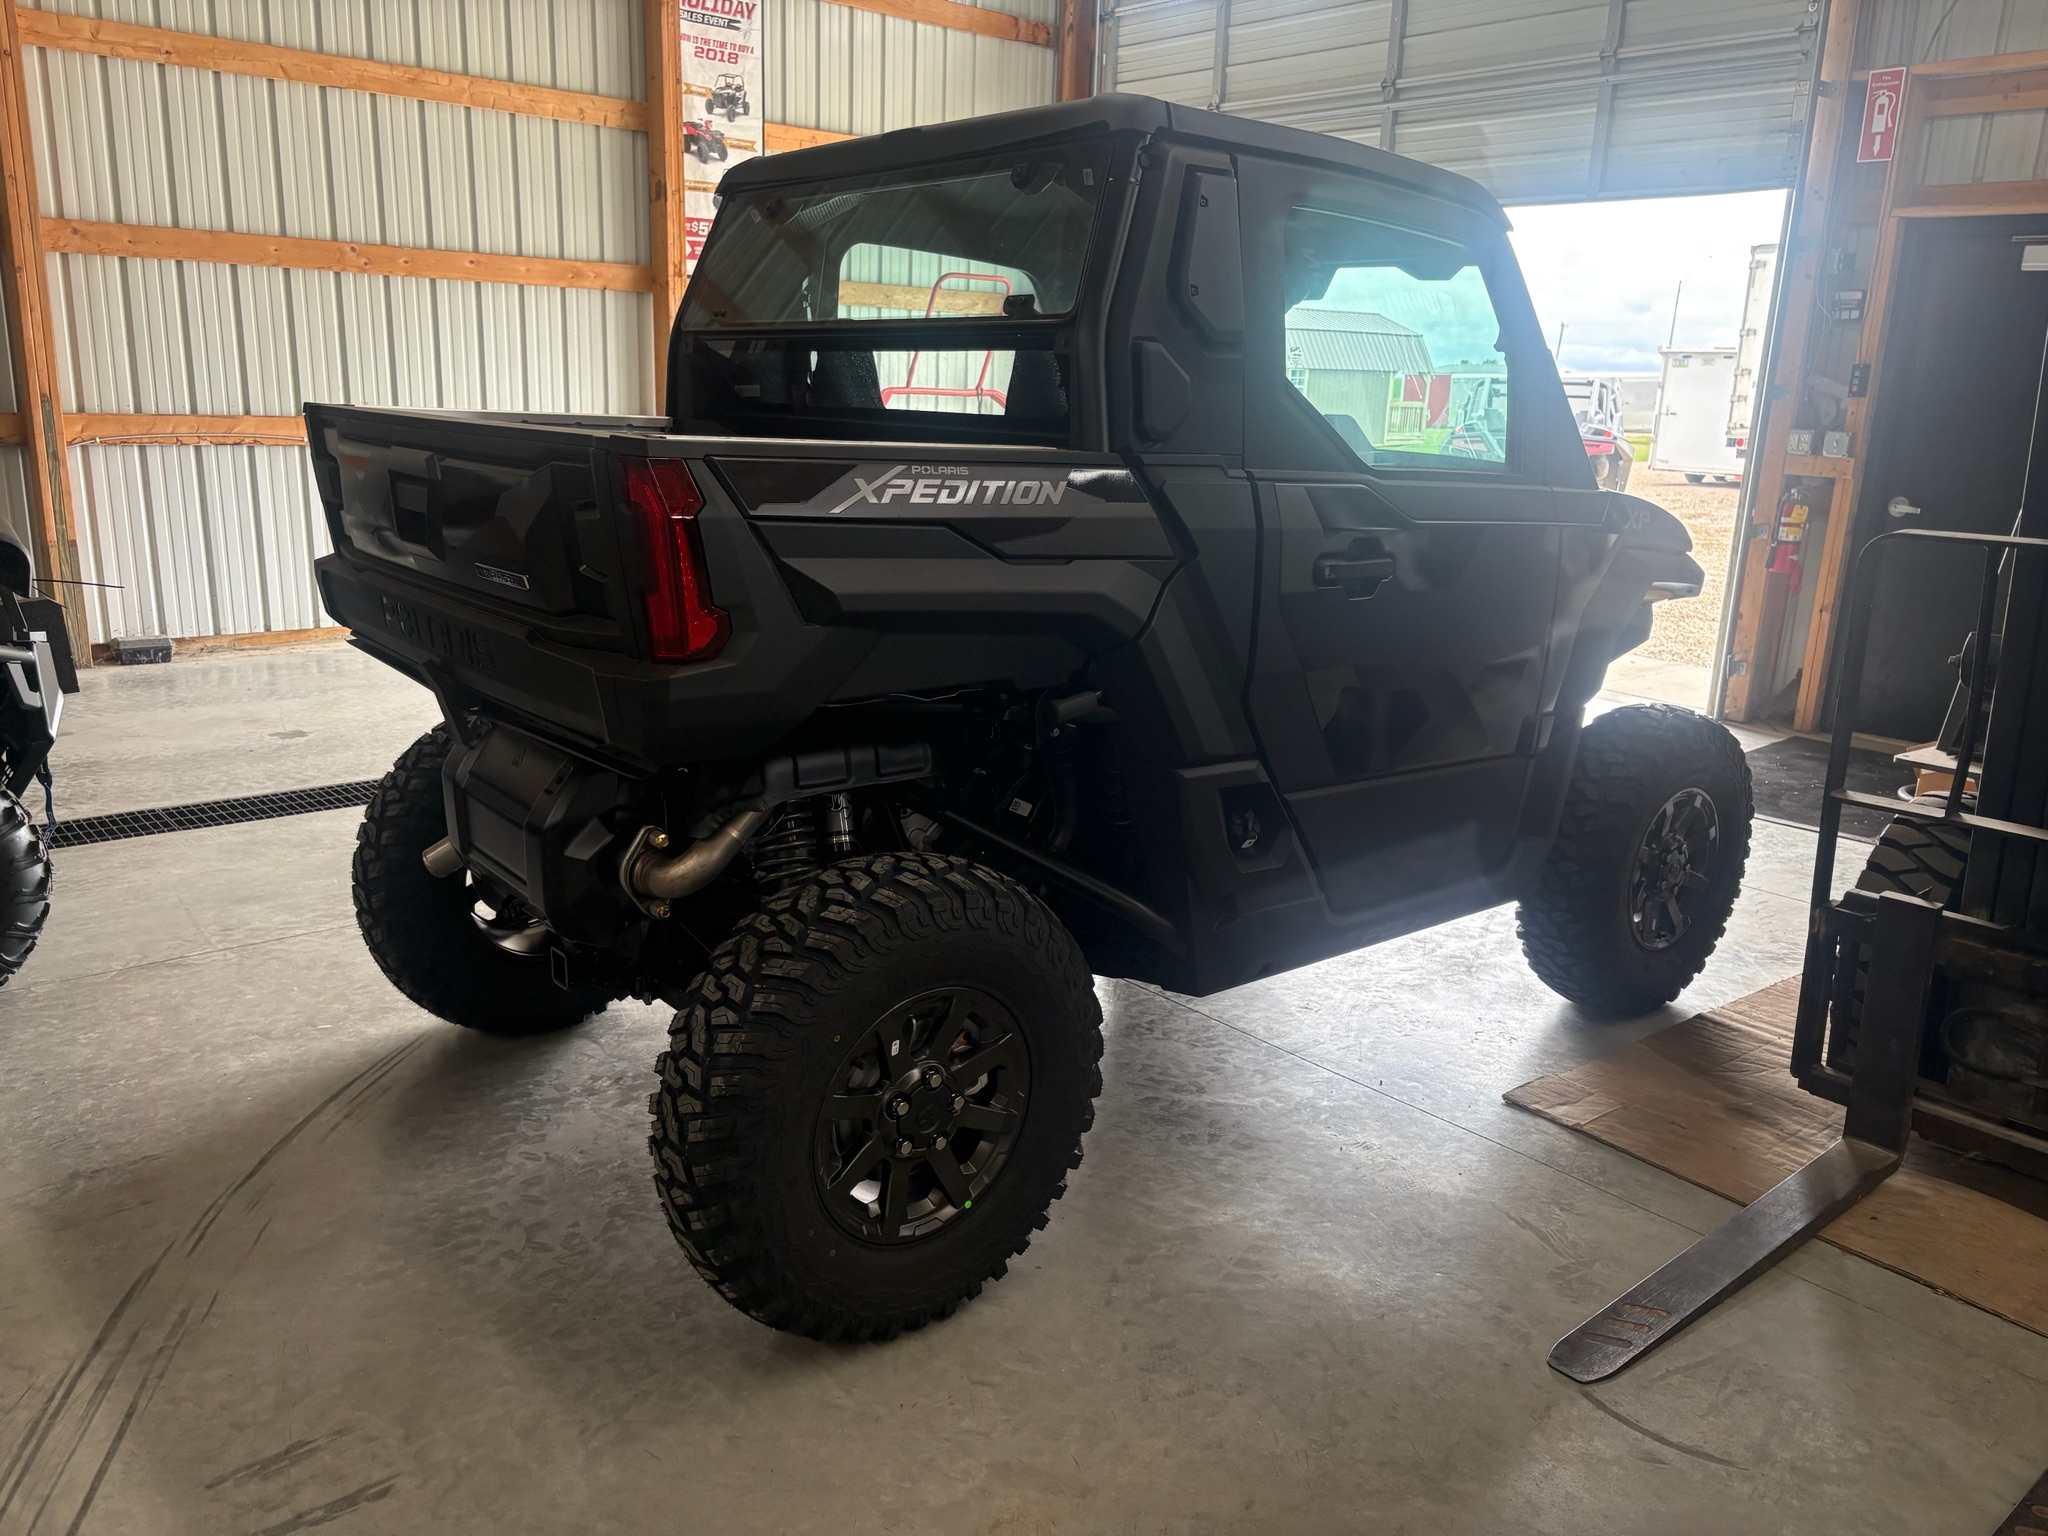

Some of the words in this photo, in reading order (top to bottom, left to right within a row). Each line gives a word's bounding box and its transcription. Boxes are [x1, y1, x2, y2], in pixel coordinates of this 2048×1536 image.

[704, 15, 729, 28] EVENT
[692, 36, 699, 44] IS
[700, 37, 711, 47] THE
[712, 39, 728, 50] TIME
[729, 42, 737, 51] TO
[738, 44, 750, 54] BUY
[694, 46, 739, 65] 2018
[691, 220, 713, 236] $5
[911, 465, 969, 476] POLARIS
[828, 465, 1070, 514] XPEDITION
